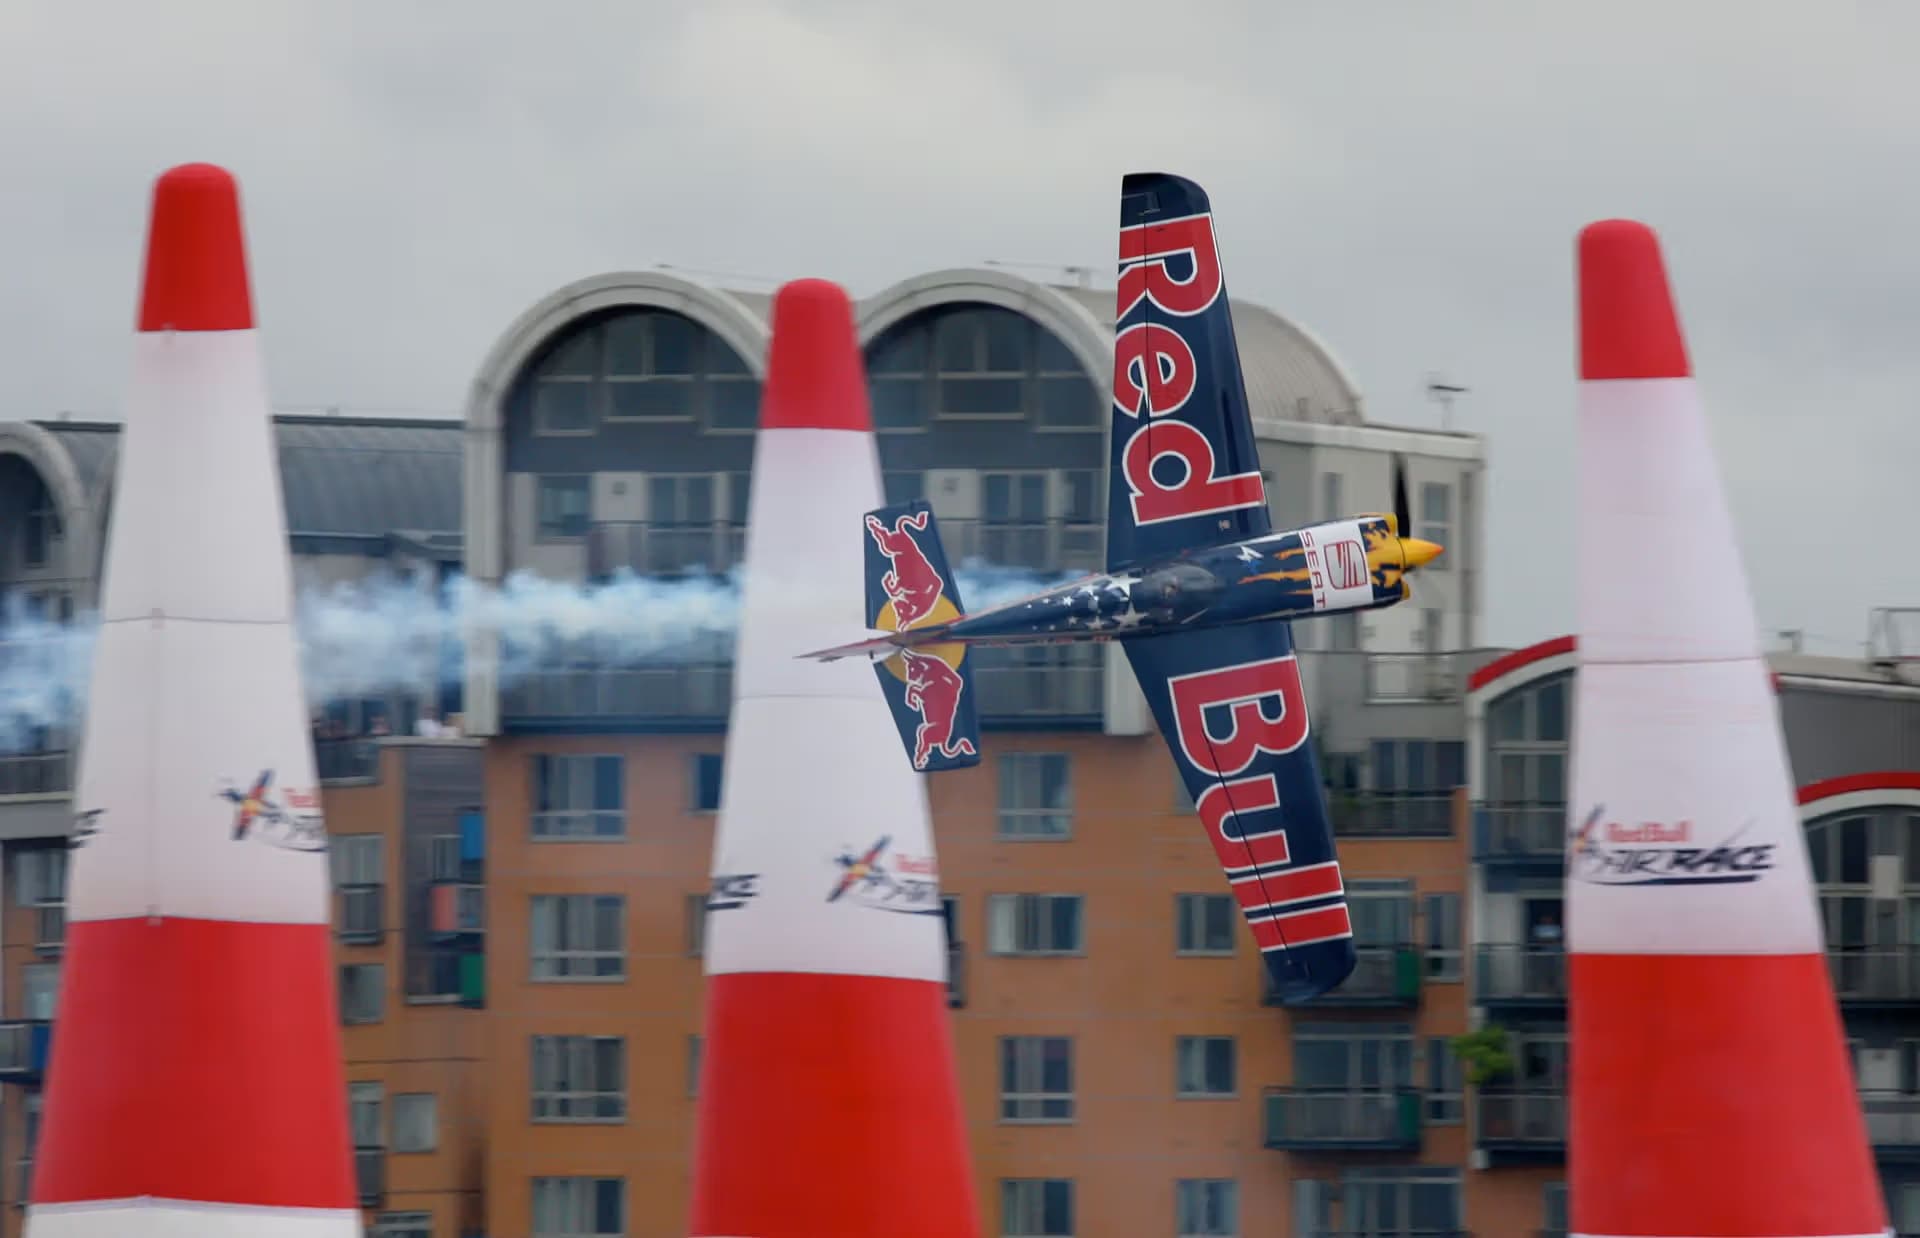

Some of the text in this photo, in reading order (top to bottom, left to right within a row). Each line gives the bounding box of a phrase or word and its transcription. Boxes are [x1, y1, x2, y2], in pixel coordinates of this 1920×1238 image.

[1113, 212, 1353, 953] Red Bull
[1301, 530, 1327, 609] SEAT
